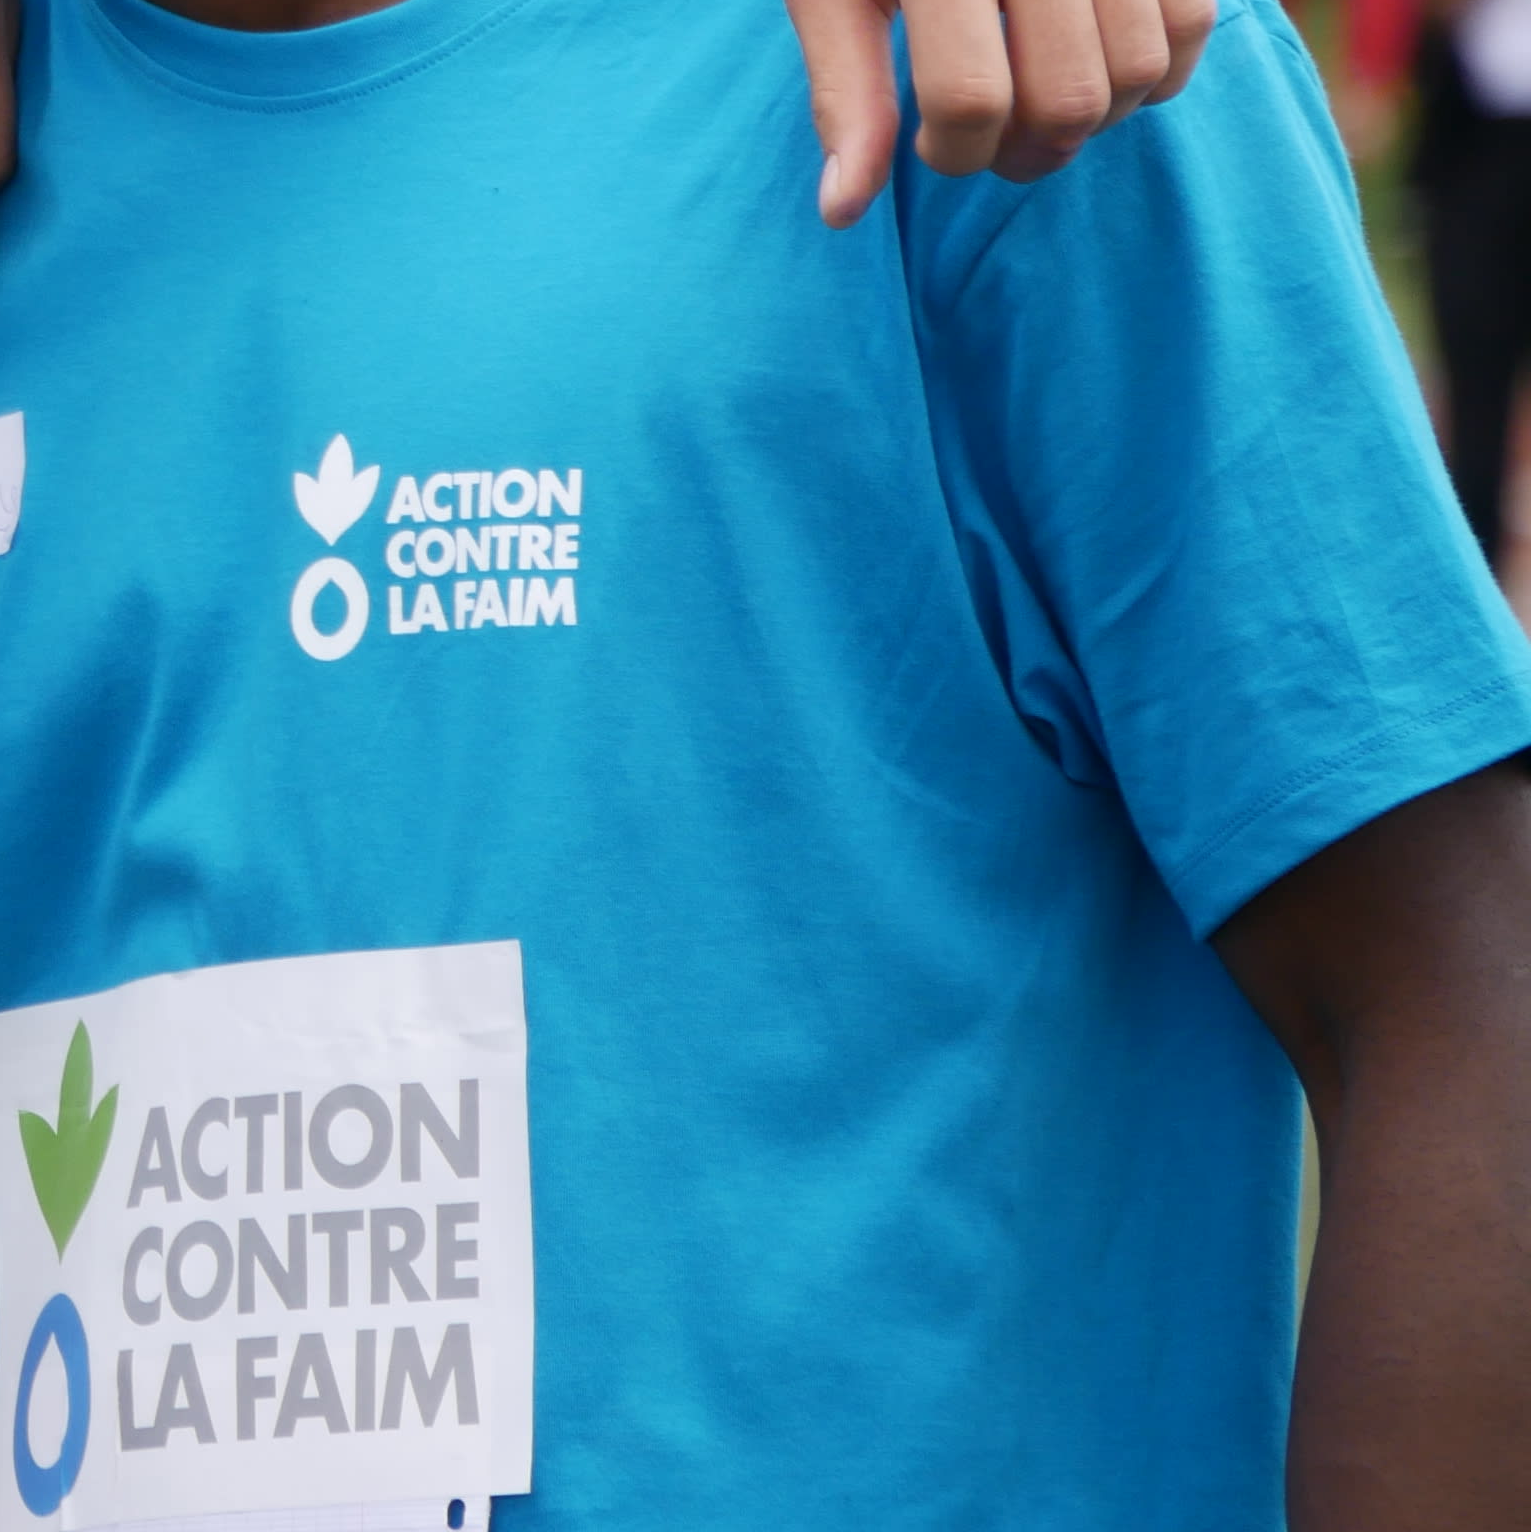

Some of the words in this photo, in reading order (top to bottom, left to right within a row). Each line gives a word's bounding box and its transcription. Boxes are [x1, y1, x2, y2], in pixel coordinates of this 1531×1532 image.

[385, 467, 583, 526] ACTION
[385, 523, 581, 579] CONTRE
[387, 586, 448, 635] LA
[454, 577, 579, 631] FAIM
[125, 1078, 480, 1209] ACTION
[121, 1201, 480, 1327] CONTRE
[117, 1342, 218, 1453] LA
[236, 1322, 480, 1442] FAIM
